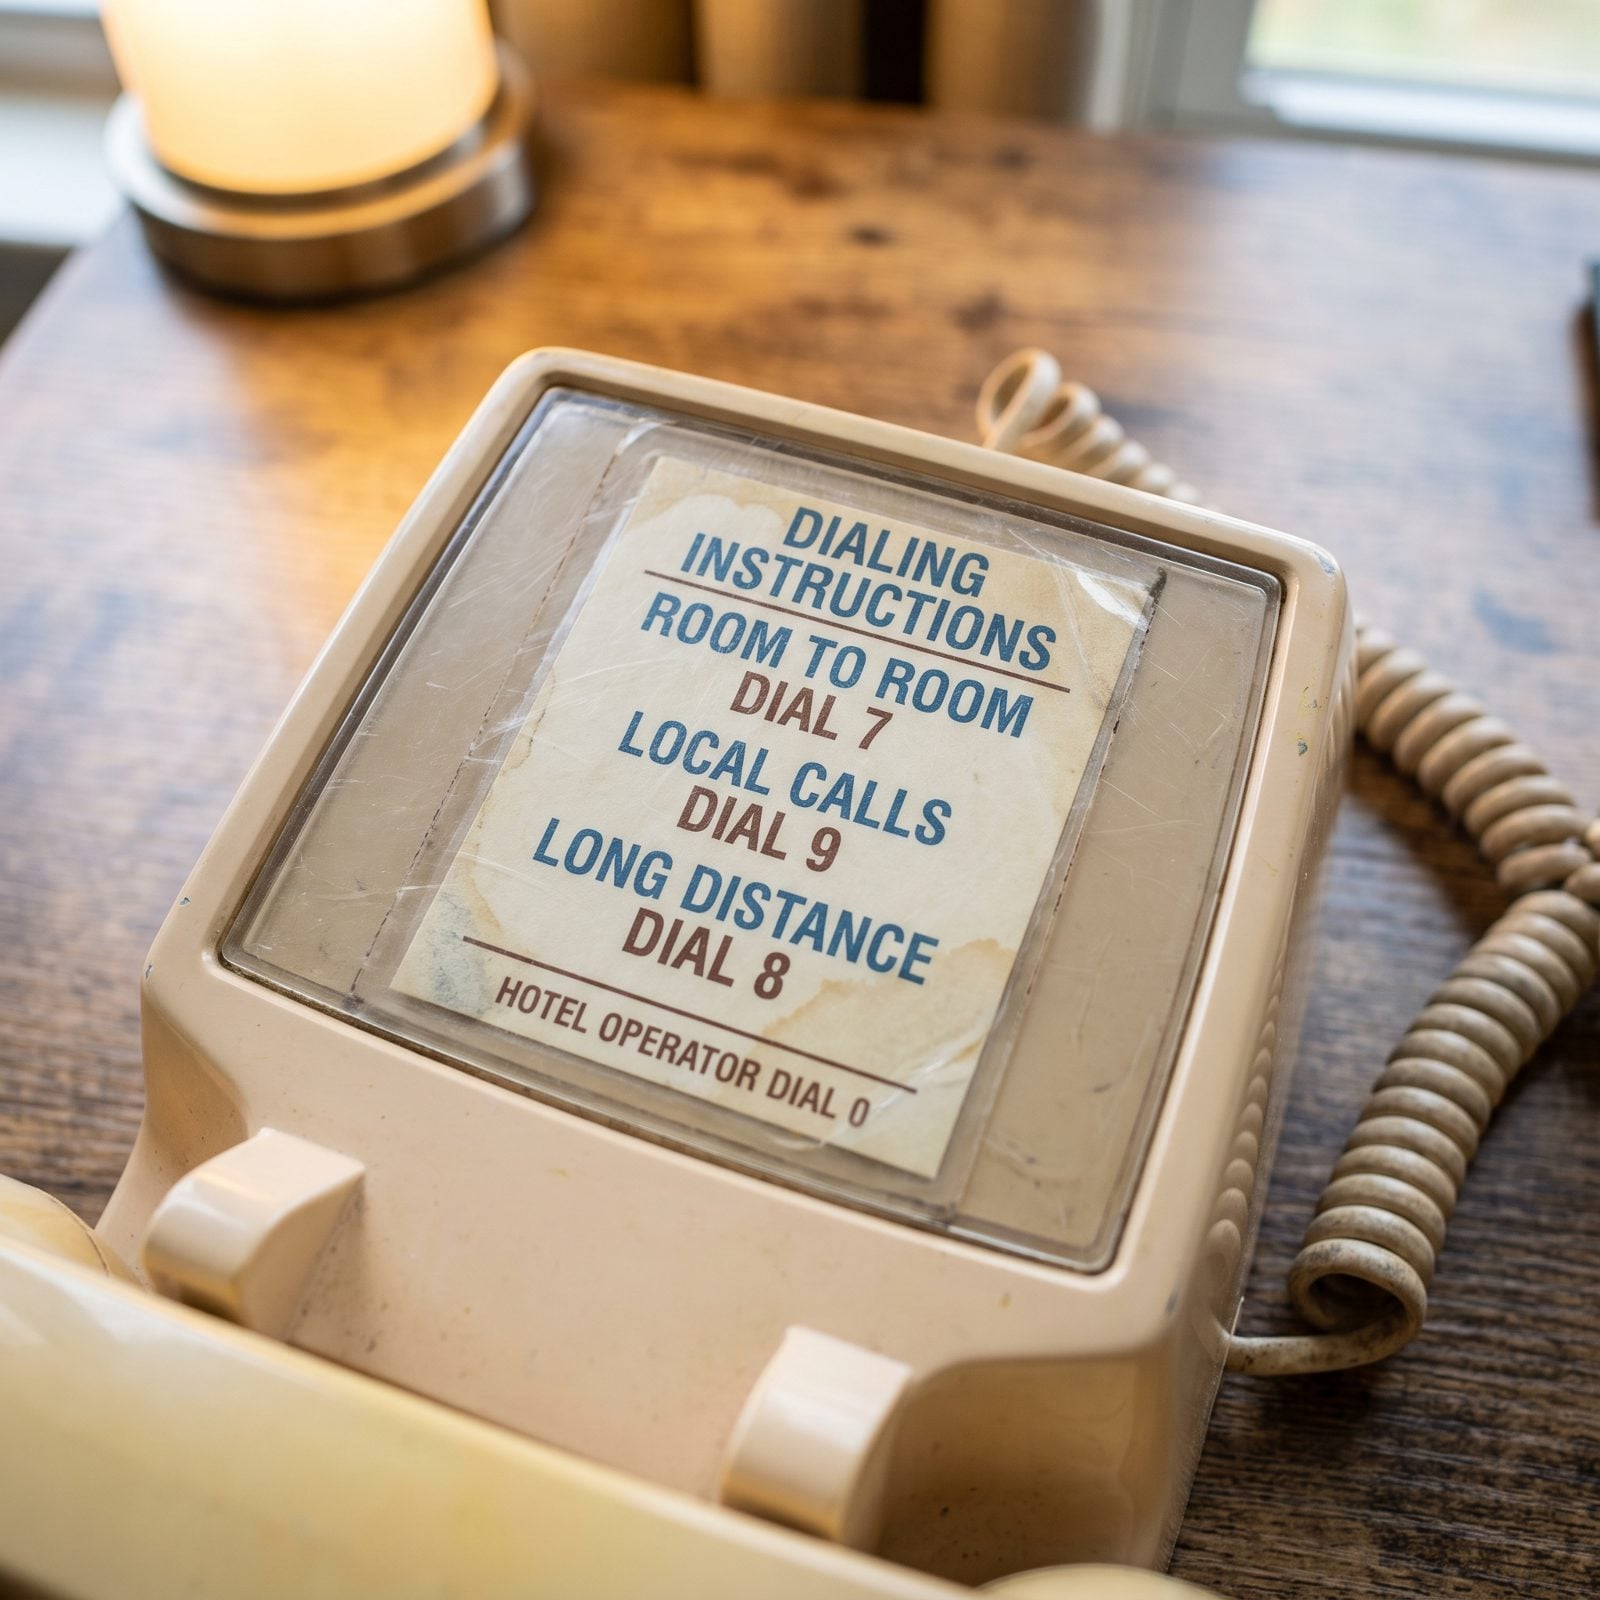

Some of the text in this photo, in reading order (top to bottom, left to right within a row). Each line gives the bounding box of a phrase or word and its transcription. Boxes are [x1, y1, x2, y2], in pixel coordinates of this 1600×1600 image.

[680, 533, 1057, 671] INSTRUCTIONS
[784, 506, 990, 597] DIALING
[640, 591, 1035, 739] ROOM TO ROOM
[729, 670, 894, 751] DIAL 7
[617, 710, 952, 846] LOCAL CALLS
[676, 784, 842, 873] DIAL 9
[532, 817, 940, 985] LONG DISTANCE
[621, 906, 791, 1001] DIAL 8
[494, 976, 871, 1128] HOTEL OPERATOR DIAL 0
